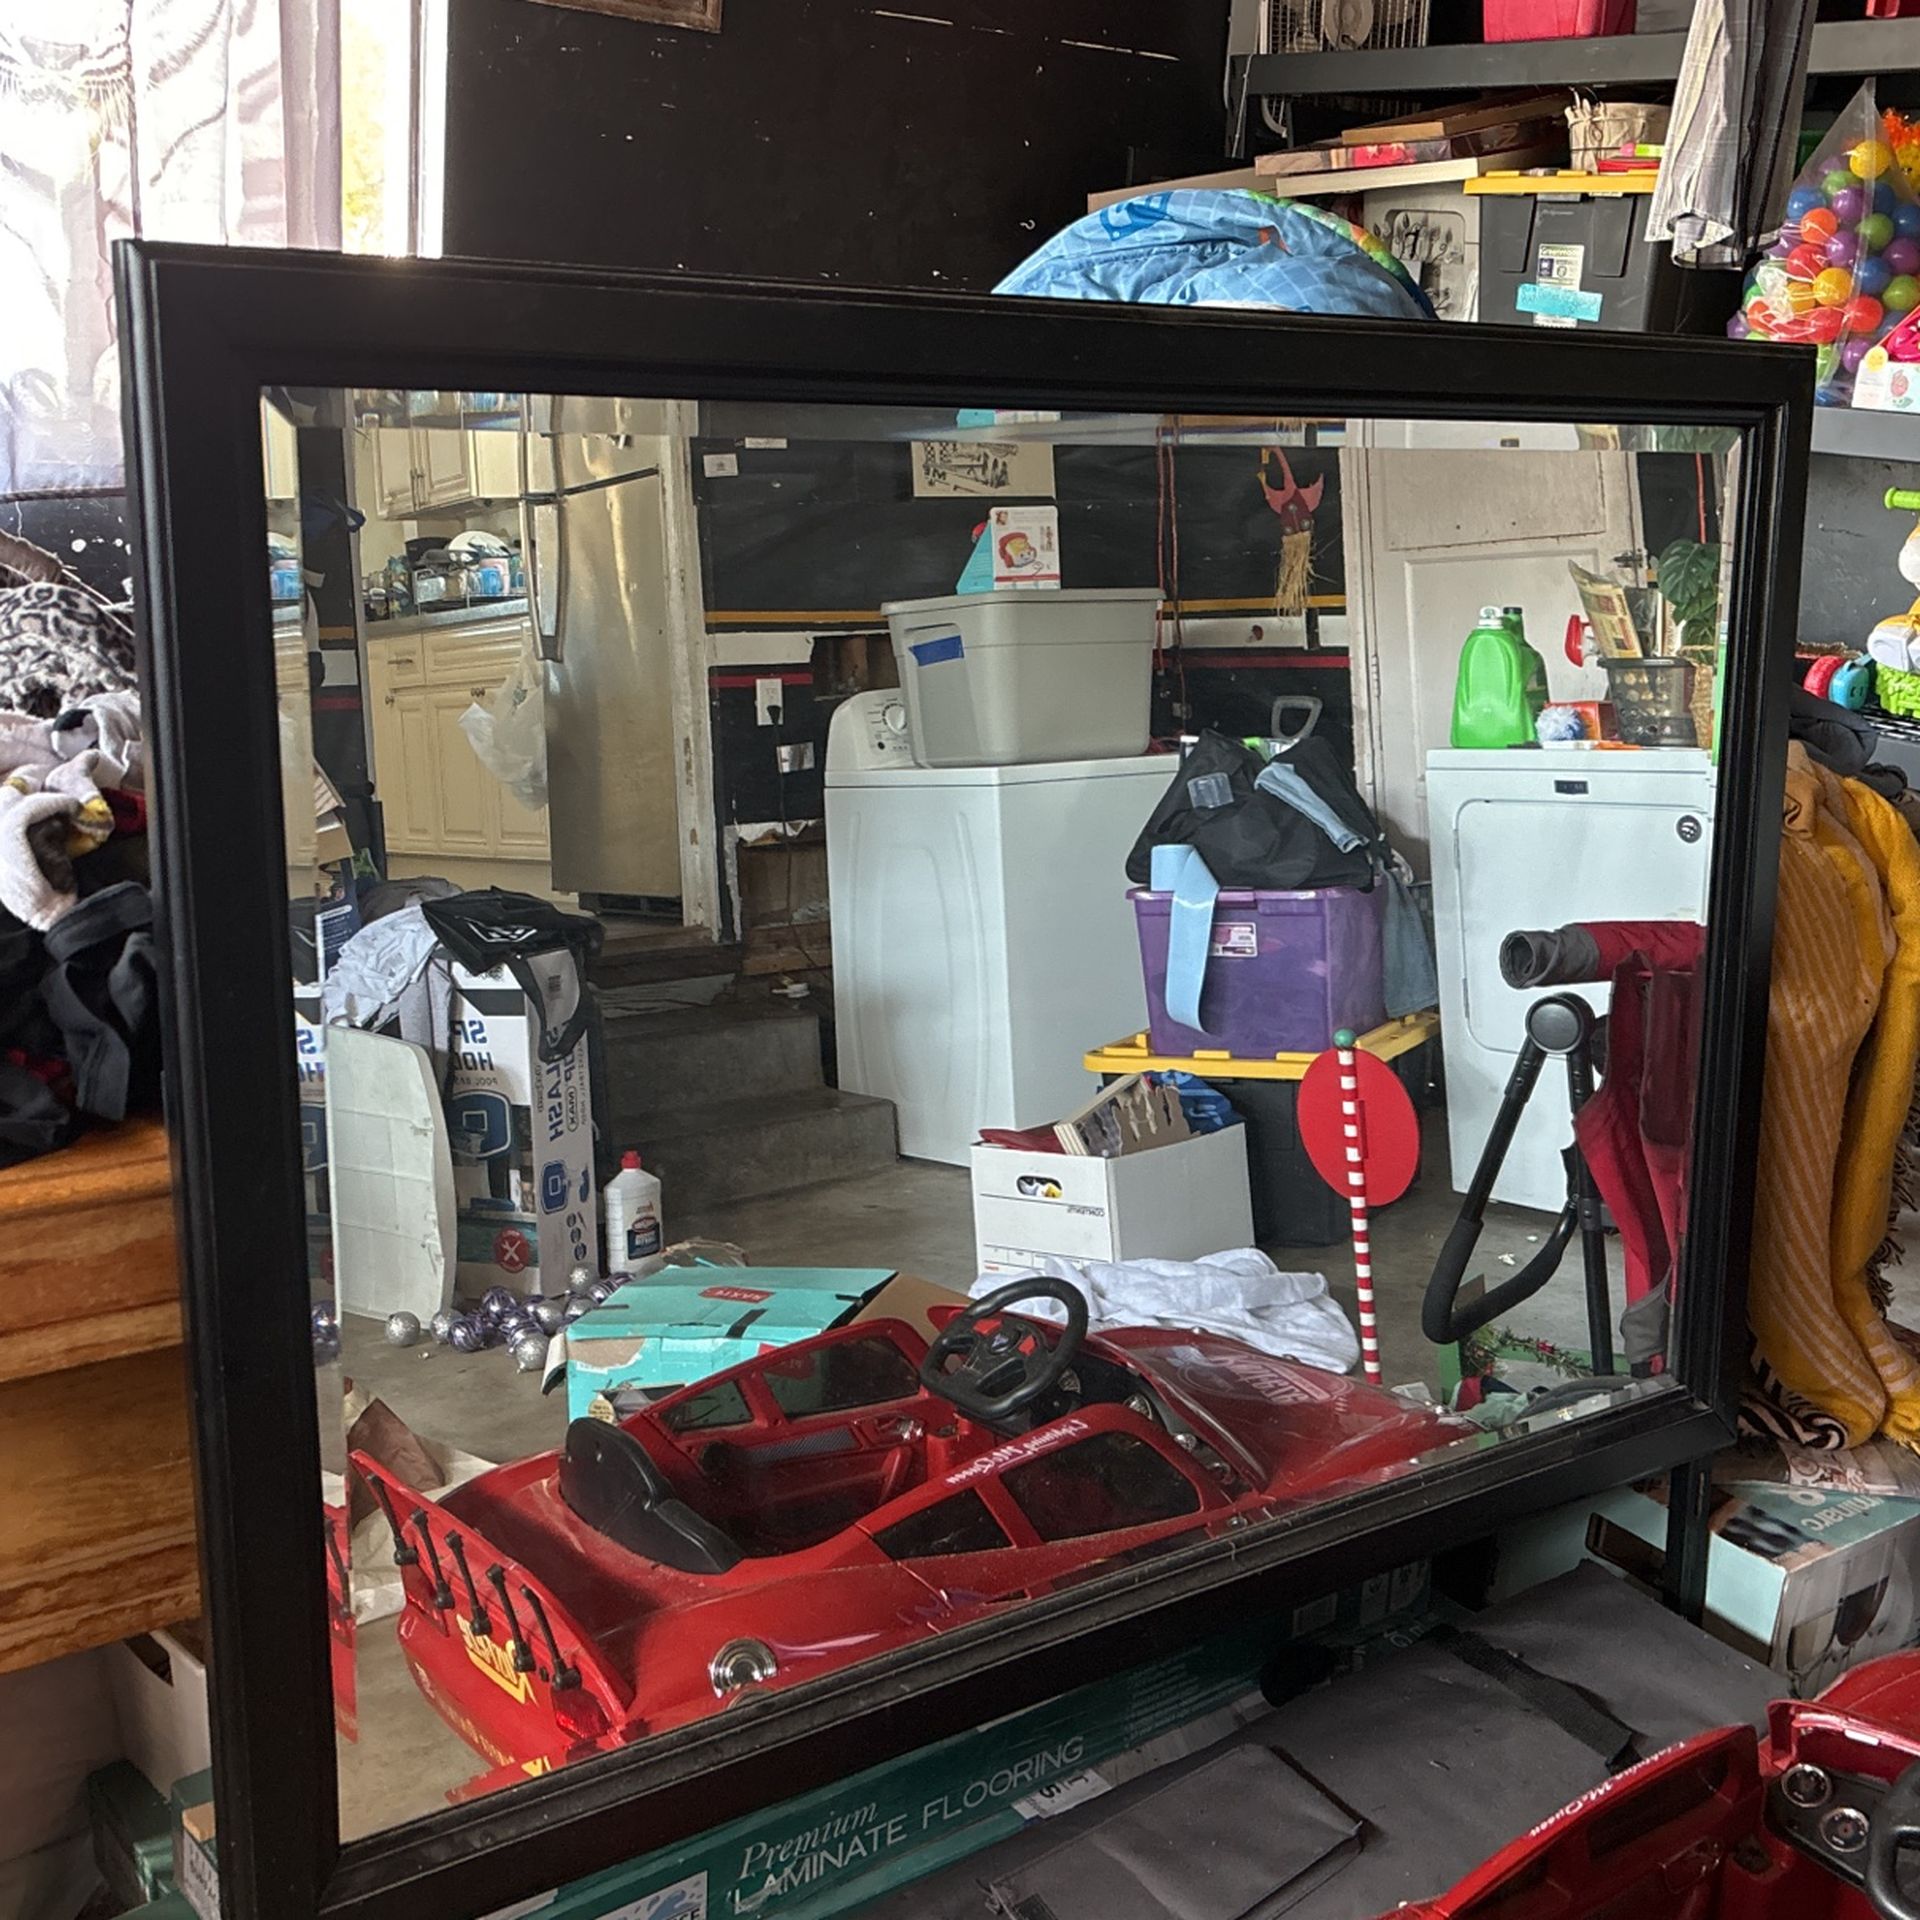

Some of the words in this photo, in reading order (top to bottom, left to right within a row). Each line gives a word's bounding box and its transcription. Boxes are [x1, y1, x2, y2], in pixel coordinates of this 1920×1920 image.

[734, 1813, 908, 1915] LAMINATE
[922, 1735, 1084, 1829] FLOORING
[738, 1802, 878, 1880] Premium
